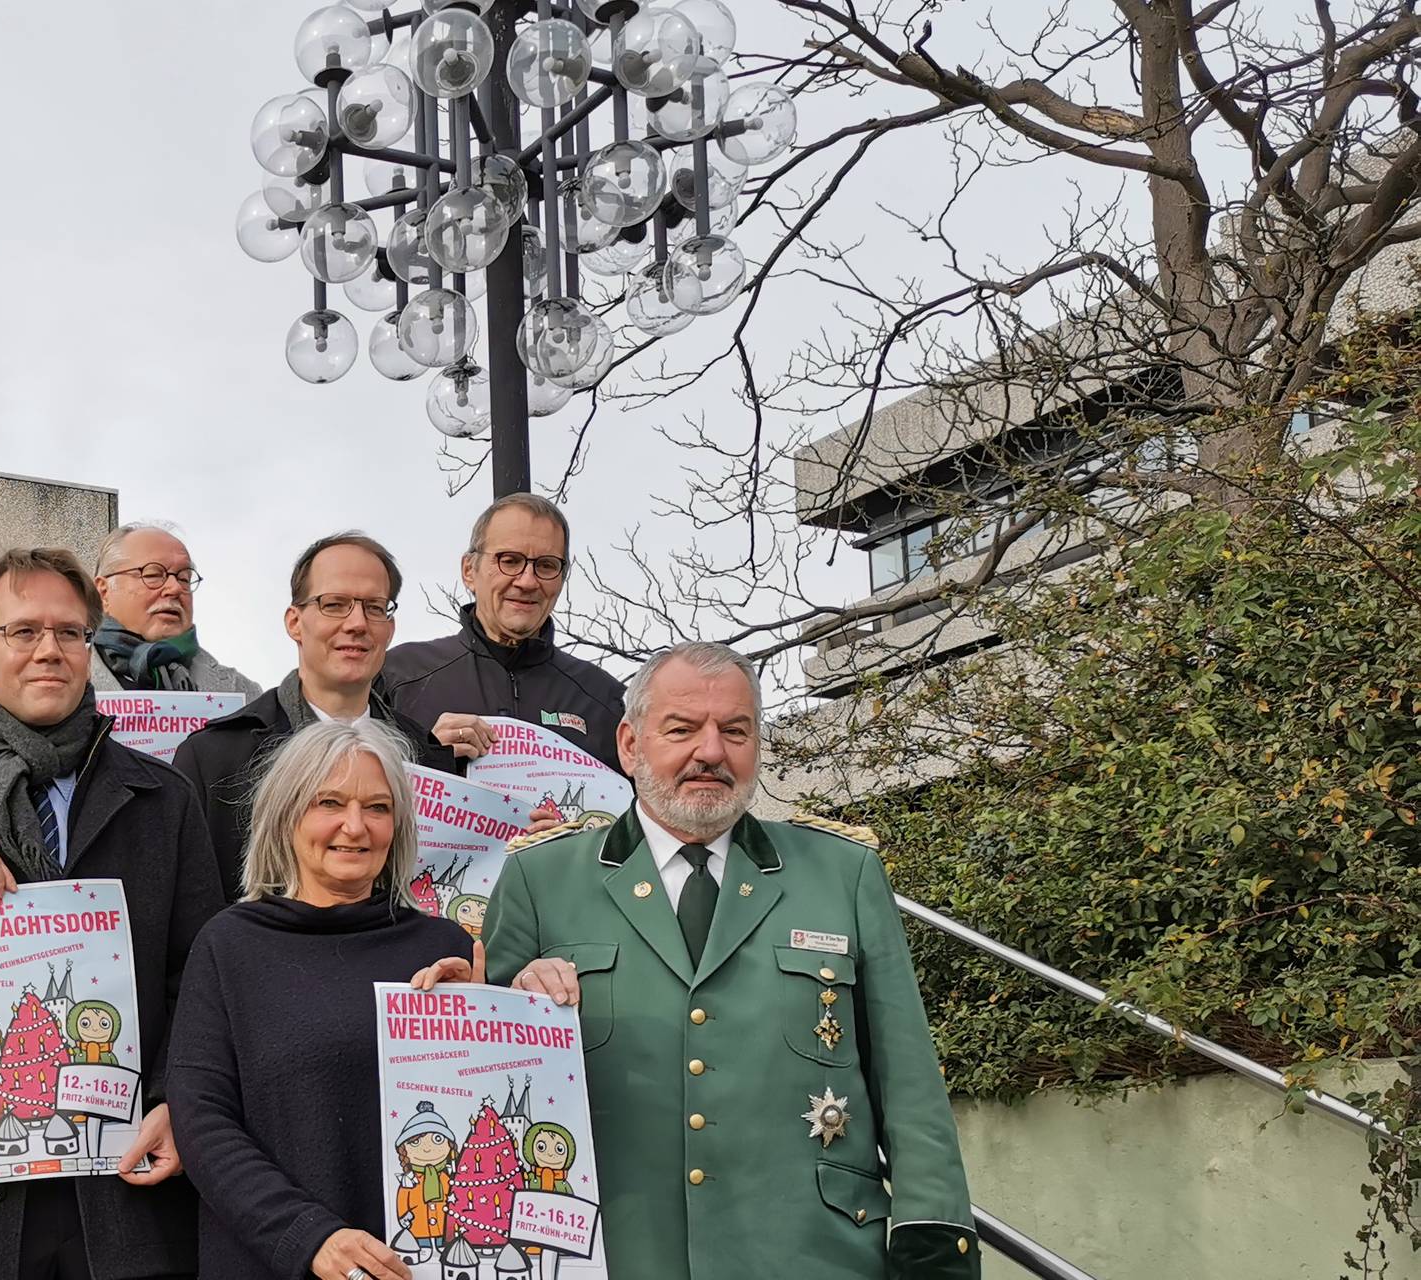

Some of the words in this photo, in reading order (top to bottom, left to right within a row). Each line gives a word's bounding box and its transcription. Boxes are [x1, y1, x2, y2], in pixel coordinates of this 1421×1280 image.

[95, 698, 161, 715] KINDER-
[386, 992, 477, 1017] KINDER-
[387, 1017, 574, 1049] WEIHNACHTSDORF
[389, 1050, 470, 1064] WEIHNACHTSBÄCKEREI
[457, 1057, 543, 1078] WEIHNACHTSGESCHICHTEN
[64, 1075, 131, 1097] 12.-16.12.
[396, 1081, 439, 1094] GESCHENKE
[440, 1086, 473, 1098] BASTELN
[61, 1092, 128, 1110] FRITZ-KÜHN-PLATZ
[518, 1201, 589, 1231] 12.-16.12.
[515, 1220, 586, 1245] FRITZ-KÜHN-PLATZ
